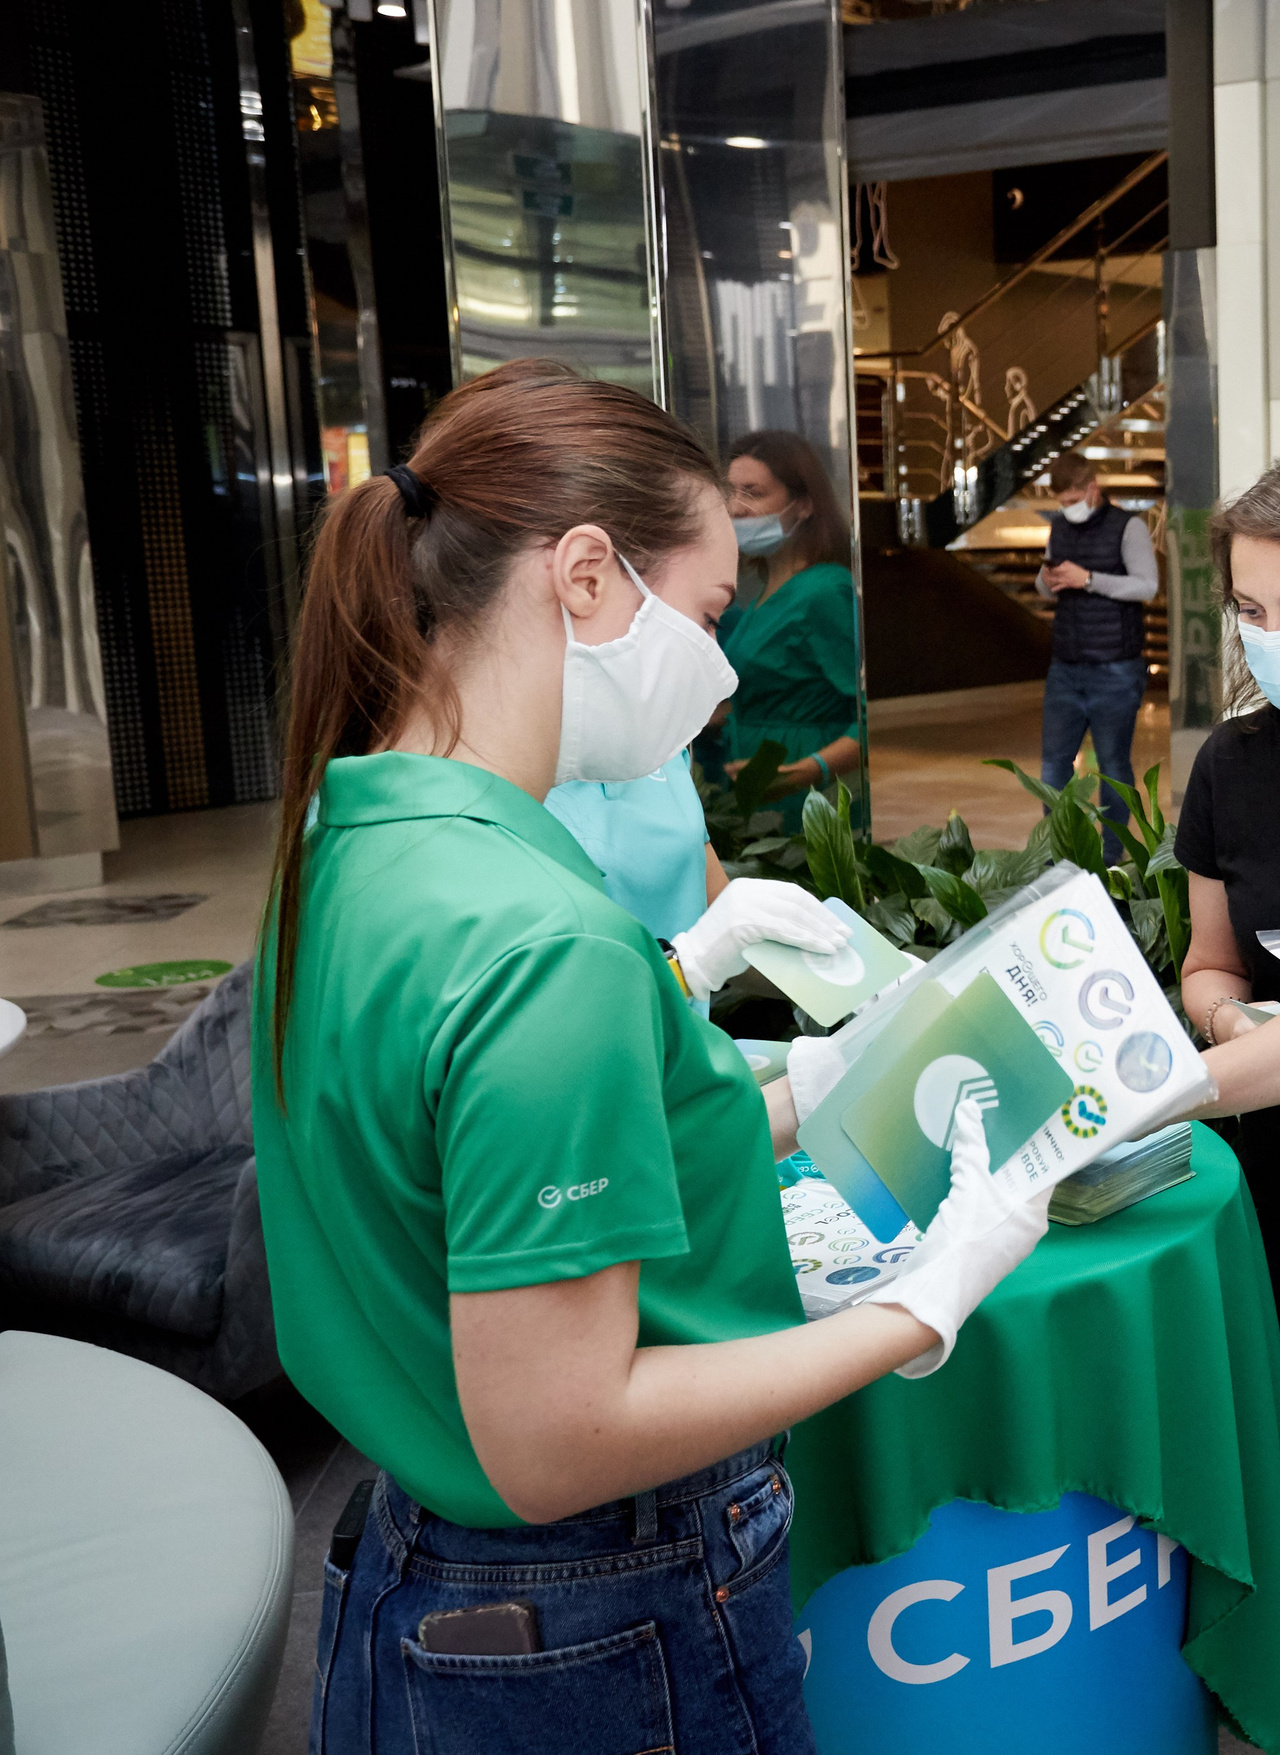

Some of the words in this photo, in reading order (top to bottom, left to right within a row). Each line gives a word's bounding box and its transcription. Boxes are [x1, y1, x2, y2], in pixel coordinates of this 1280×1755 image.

[1005, 965, 1038, 1007] ДНЯ!
[1020, 1149, 1039, 1182] ВОЕ
[1030, 1141, 1050, 1174] РОБУЙ
[566, 1177, 609, 1201] СБЕР
